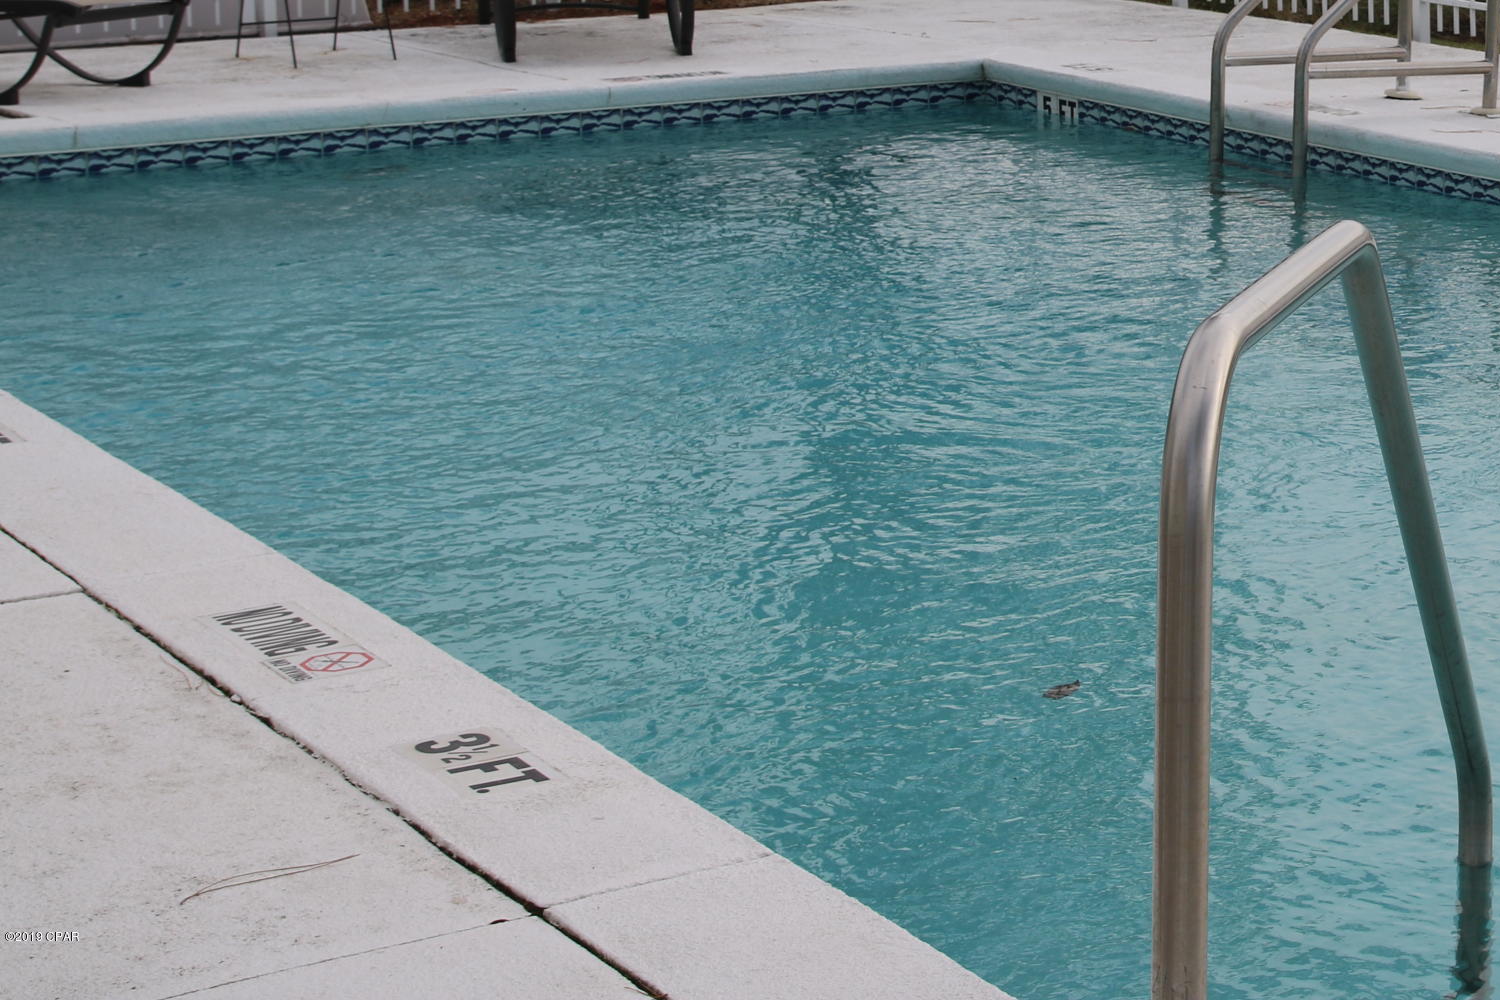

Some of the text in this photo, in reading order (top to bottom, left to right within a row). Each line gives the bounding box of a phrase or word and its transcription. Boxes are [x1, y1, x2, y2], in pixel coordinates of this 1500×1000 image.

[212, 605, 339, 657] NO DIVING
[446, 756, 550, 793] FT.
